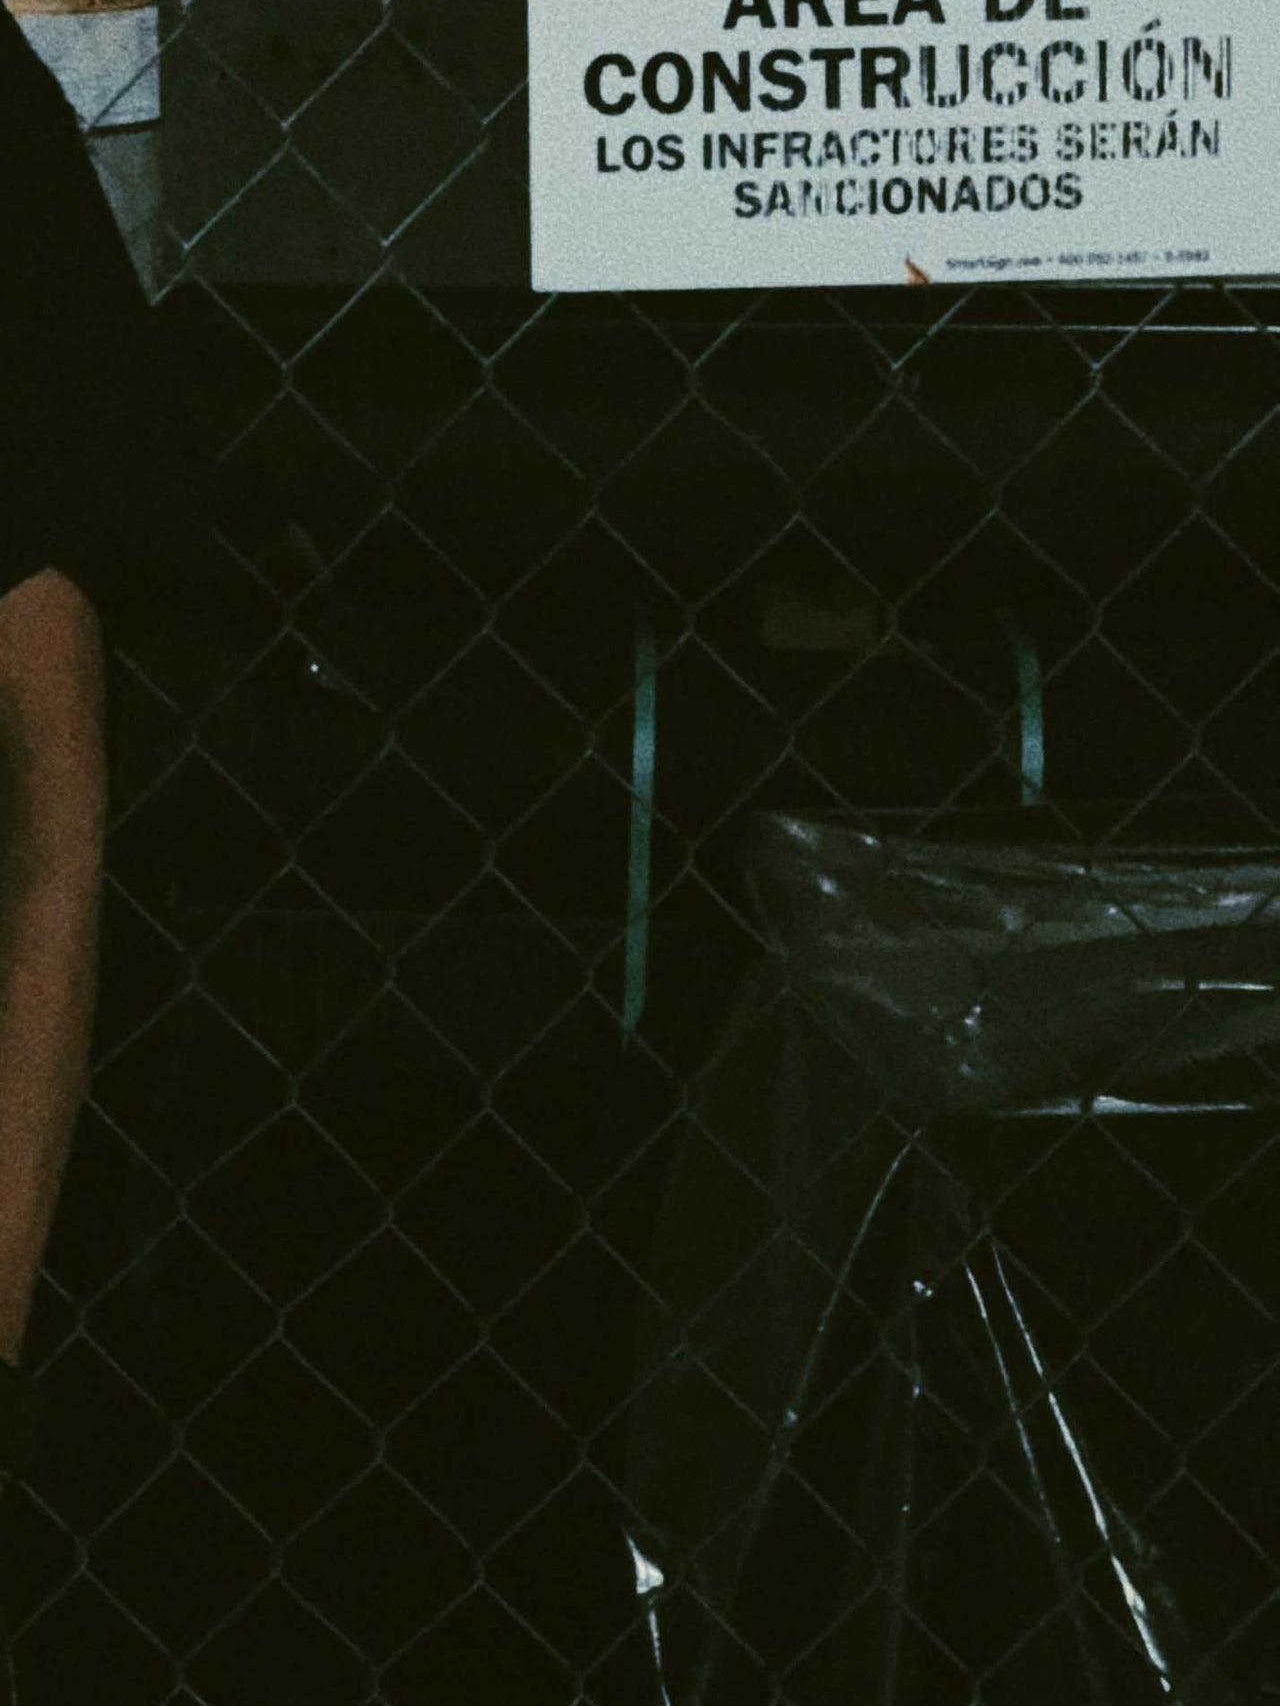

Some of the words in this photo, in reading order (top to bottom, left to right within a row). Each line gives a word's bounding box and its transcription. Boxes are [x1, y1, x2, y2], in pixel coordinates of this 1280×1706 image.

[583, 18, 1233, 116] CONSTRUCCIÓN
[596, 134, 685, 173] LOS
[702, 123, 1039, 171] INFRACTORES
[1055, 110, 1221, 162] SERÁN
[734, 172, 1083, 219] SANCIONADOS
